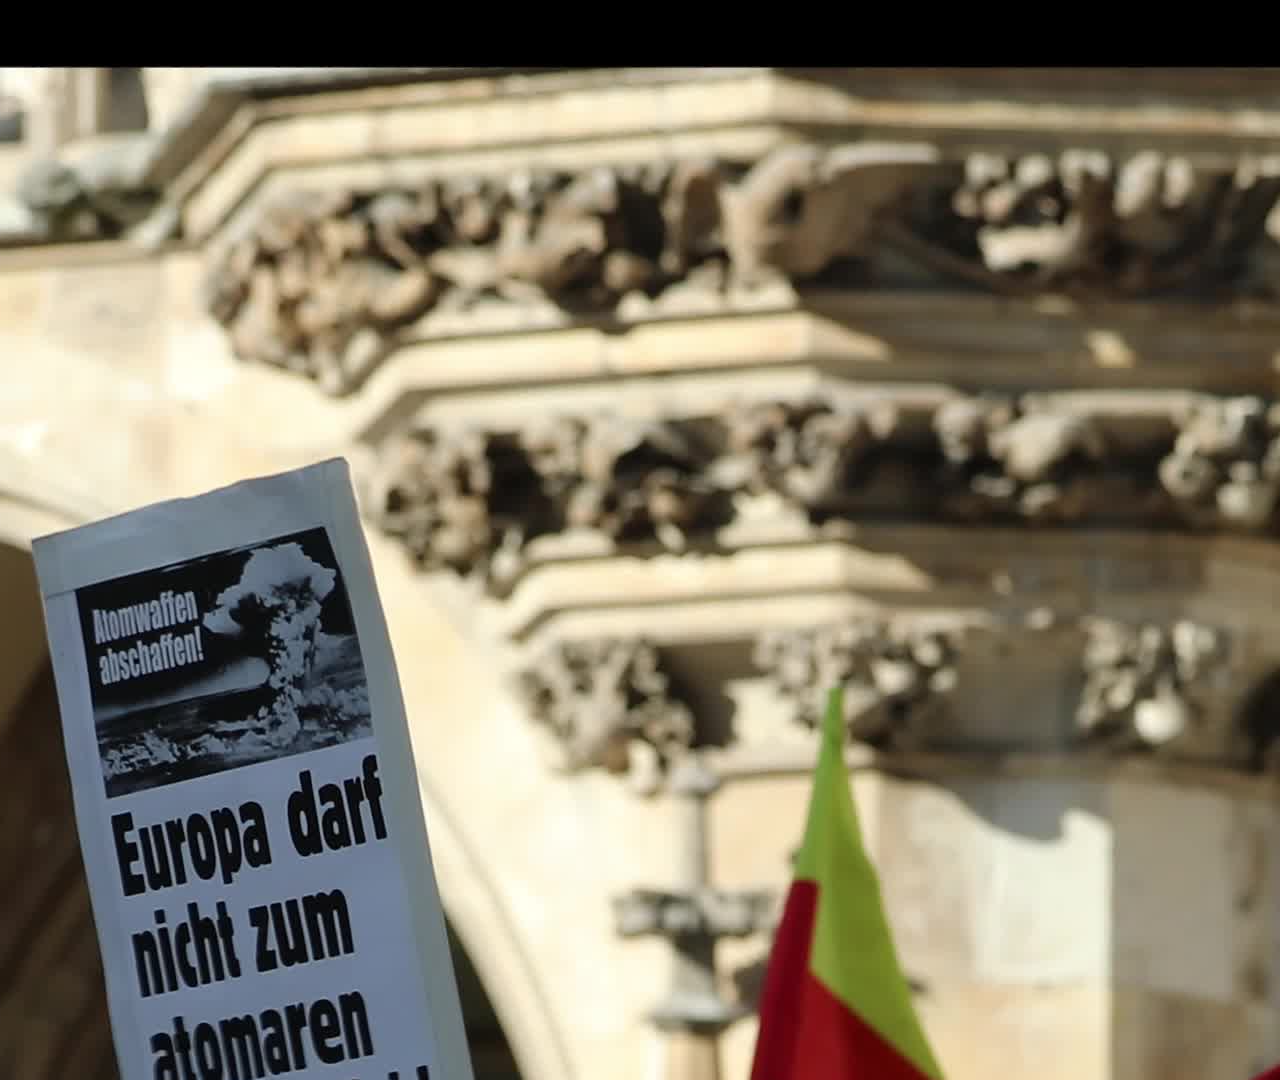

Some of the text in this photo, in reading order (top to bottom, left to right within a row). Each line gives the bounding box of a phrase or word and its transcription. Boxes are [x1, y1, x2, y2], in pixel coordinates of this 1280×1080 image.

[92, 588, 199, 645] Atomwaffen
[98, 625, 205, 686] abschaffen!
[111, 754, 388, 897] Europa darf
[131, 888, 355, 998] nicht zum
